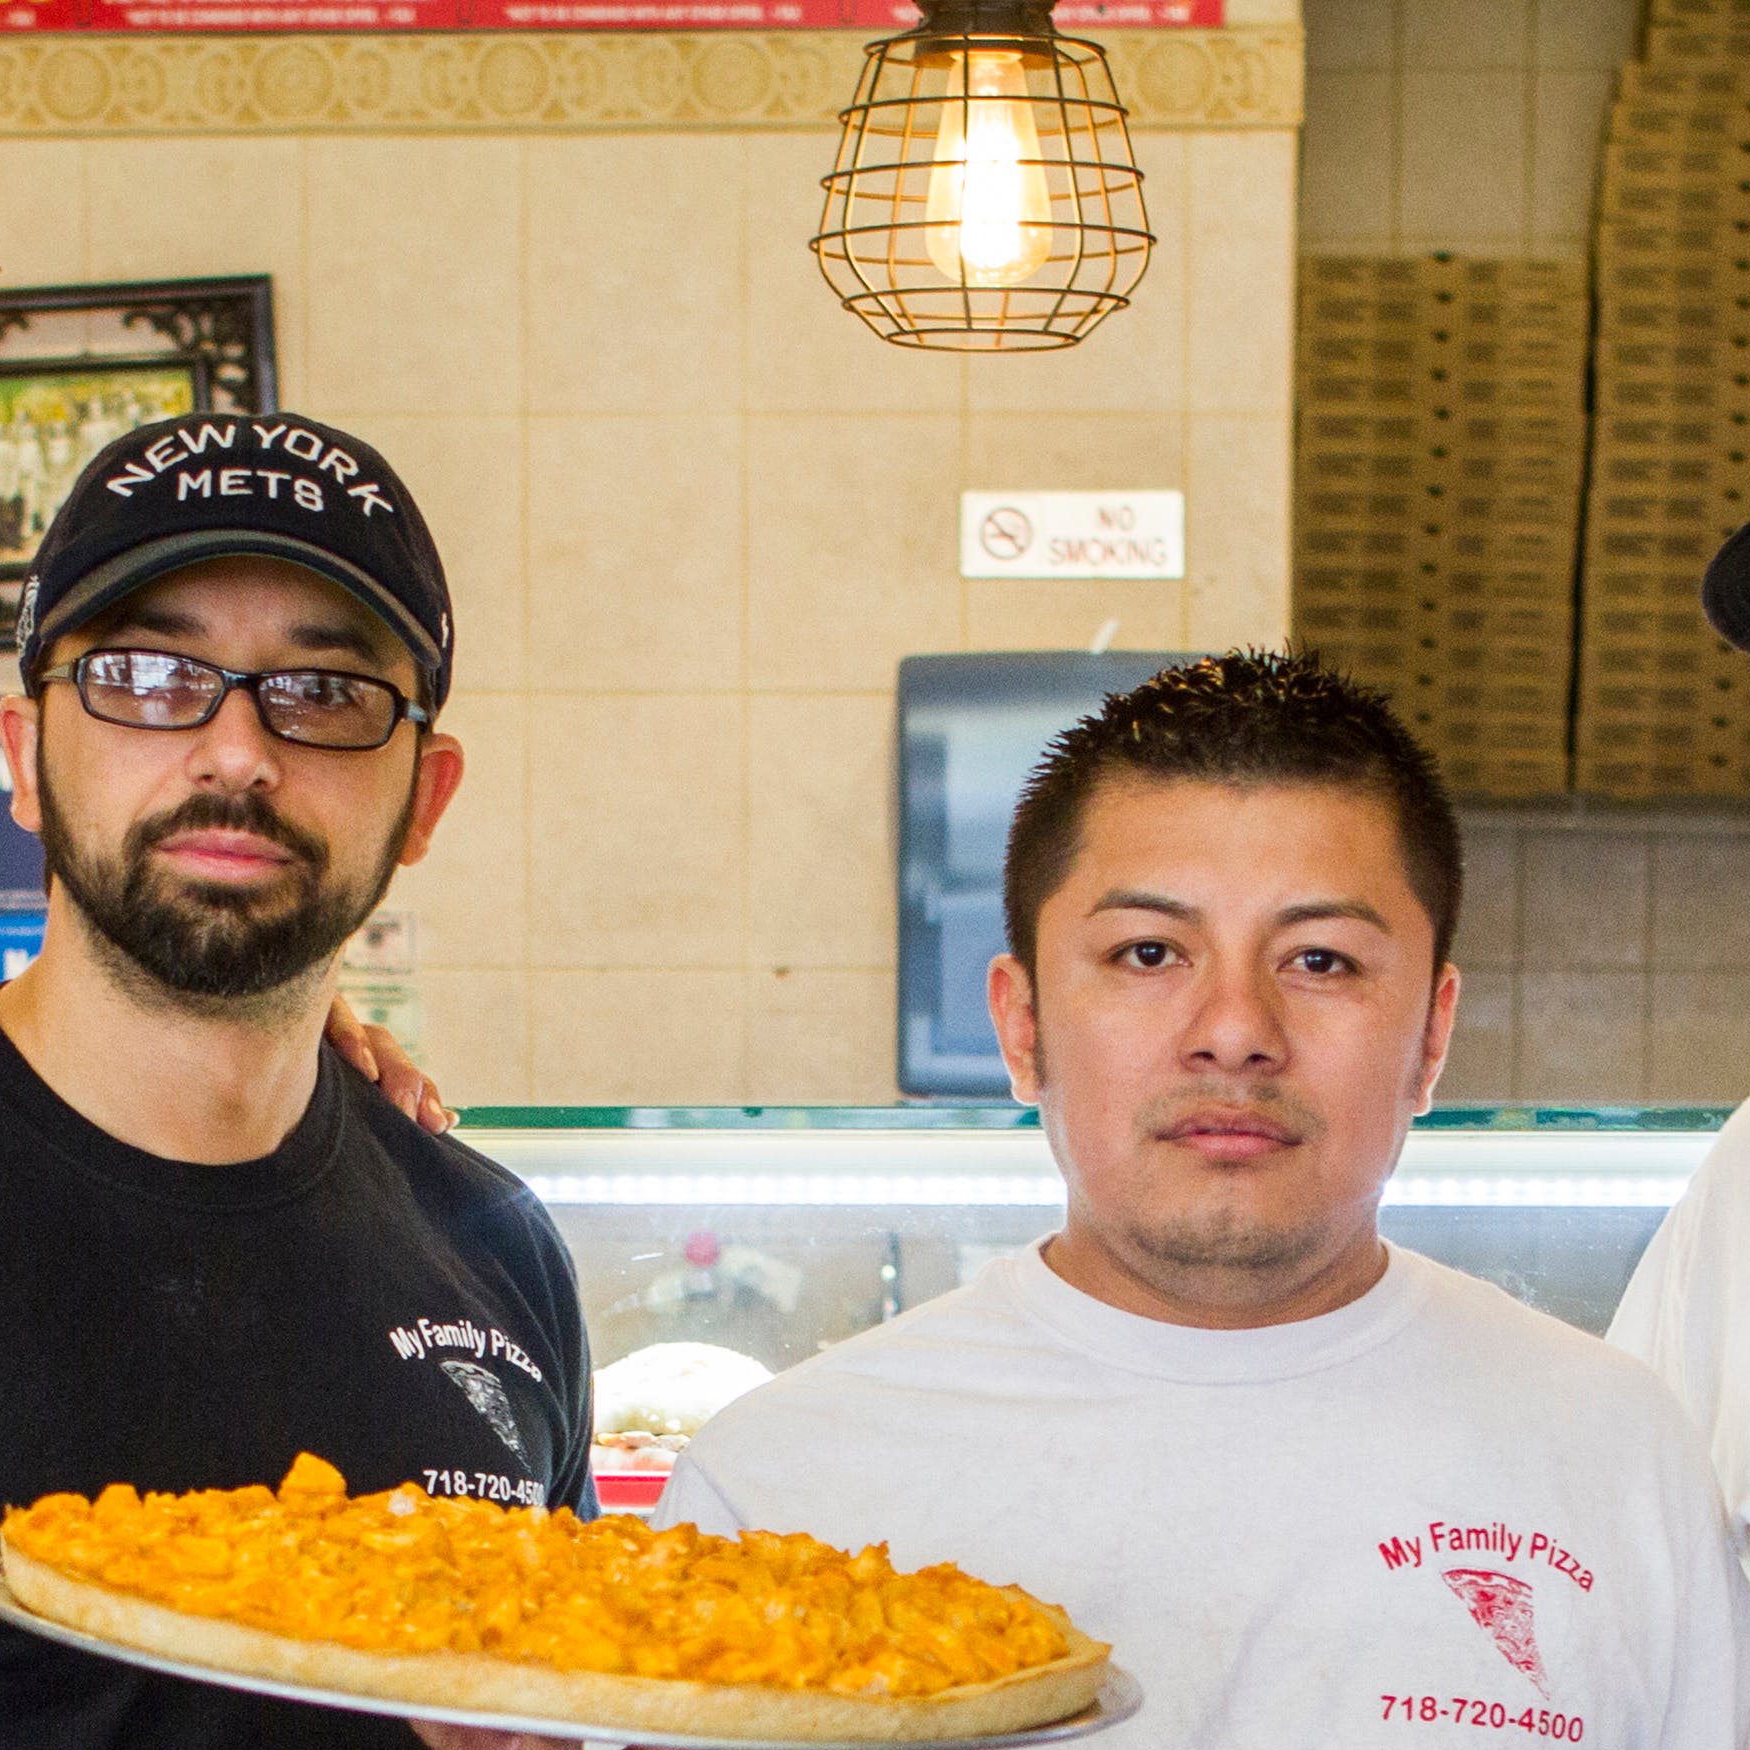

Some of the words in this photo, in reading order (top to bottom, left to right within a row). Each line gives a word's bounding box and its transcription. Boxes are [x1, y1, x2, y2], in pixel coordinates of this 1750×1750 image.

[106, 424, 236, 498] NEW
[252, 423, 394, 517] YORK
[178, 469, 324, 513] METS
[1098, 505, 1136, 531] NO
[1048, 537, 1168, 567] SMOKING
[389, 1326, 425, 1360] My
[416, 1317, 487, 1359] Family
[489, 1328, 543, 1382] Pizza
[1378, 1535, 1423, 1571] My
[1428, 1521, 1523, 1562] Family
[1528, 1532, 1595, 1593] Pizza
[1380, 1694, 1584, 1744] 718-720-4500
